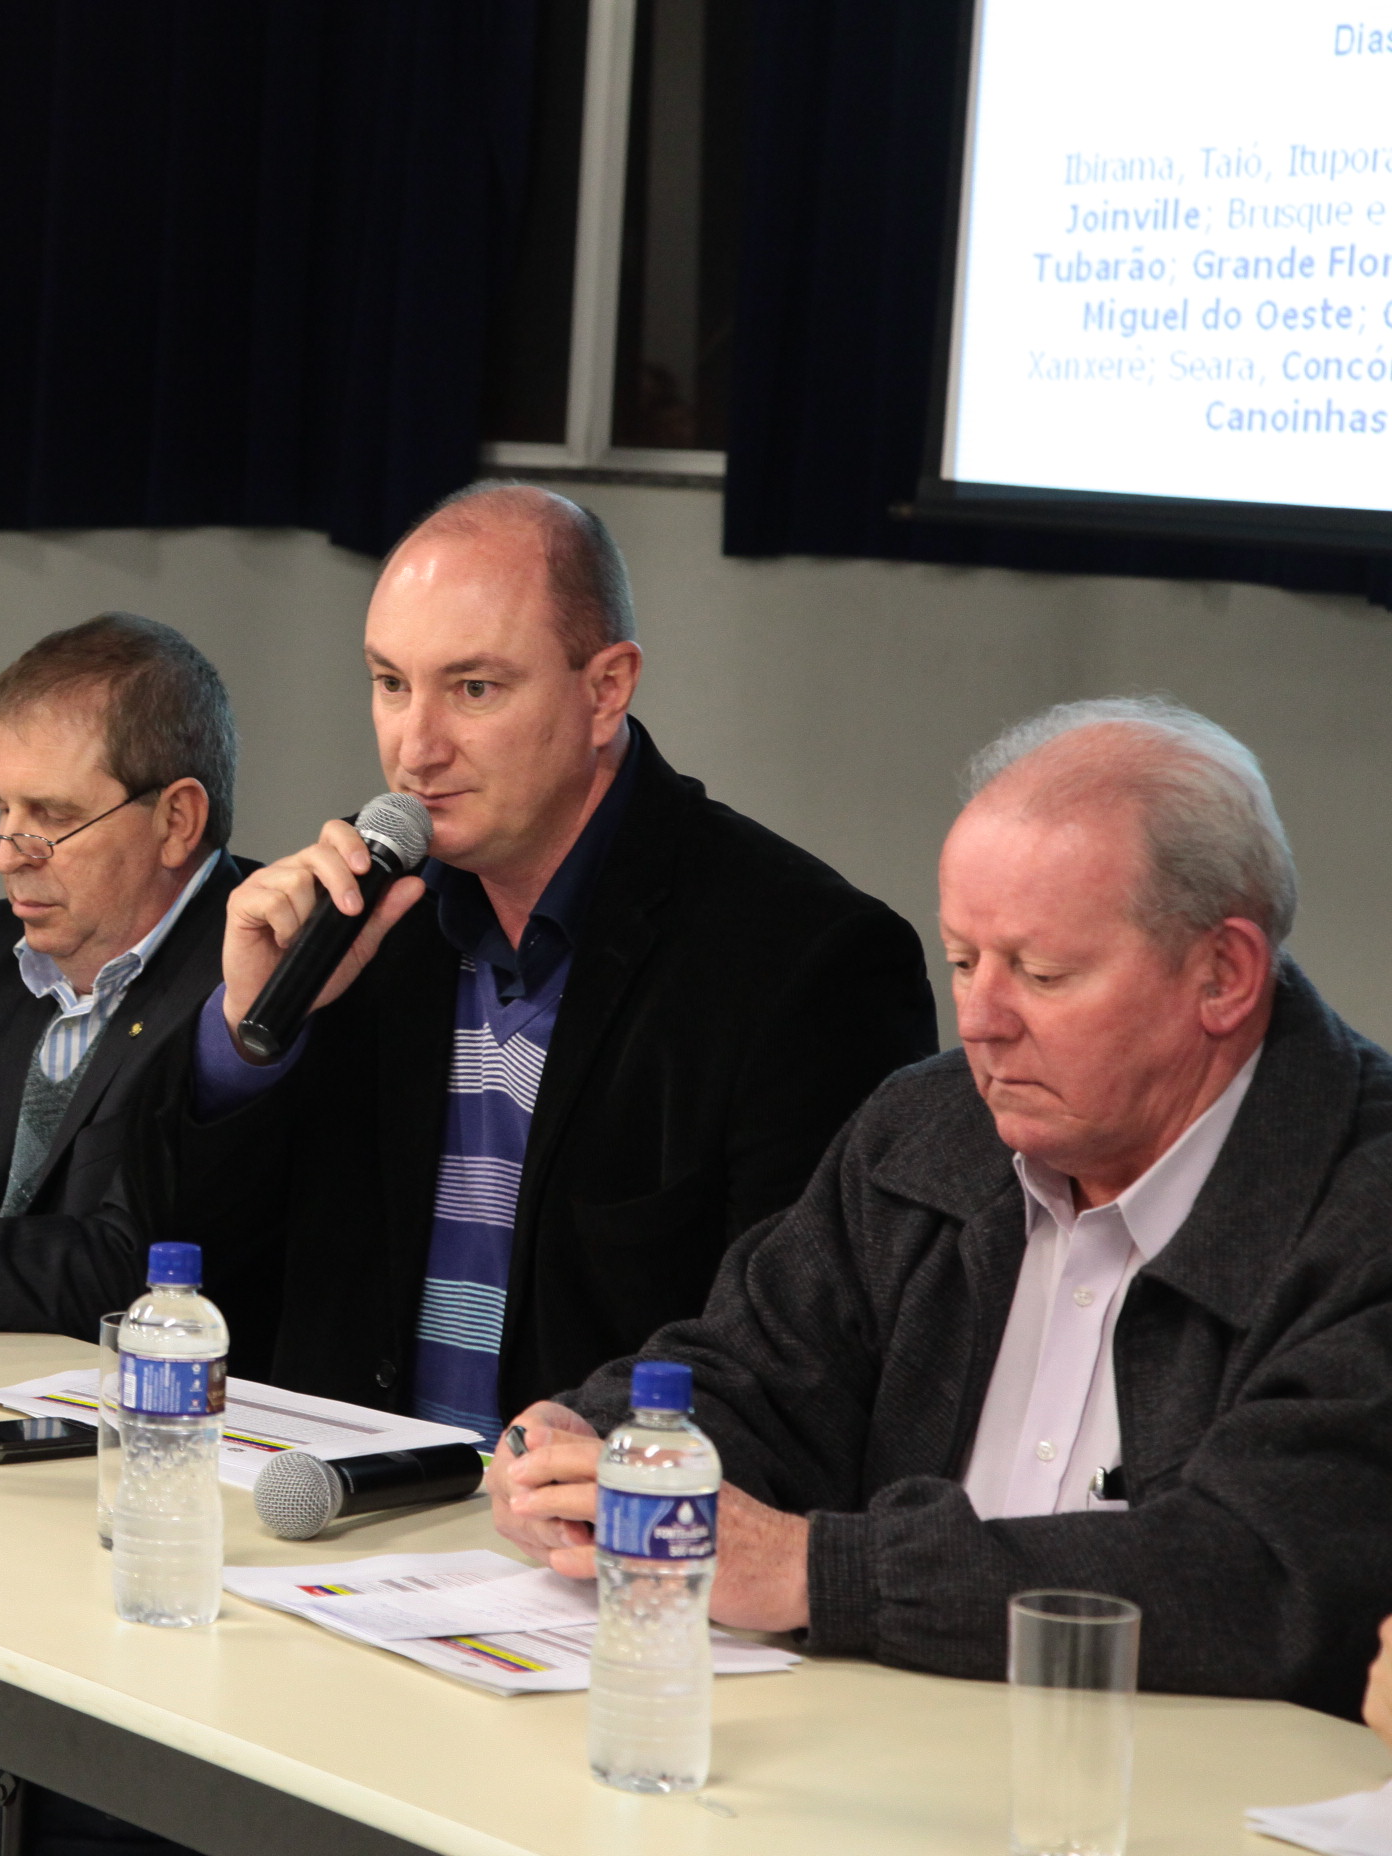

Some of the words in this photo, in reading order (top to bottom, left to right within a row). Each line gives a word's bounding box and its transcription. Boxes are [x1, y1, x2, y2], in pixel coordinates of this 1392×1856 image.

[1064, 152, 1185, 187] Ibirama,
[1200, 141, 1273, 184] Taió,
[1065, 197, 1213, 236] Joinville;
[1227, 196, 1354, 235] Brusque
[1366, 200, 1387, 226] e
[1032, 245, 1177, 285] Tubarão;
[1192, 245, 1316, 280] Grande
[1082, 297, 1189, 339] Miguel
[1201, 296, 1243, 331] do
[1256, 297, 1367, 336] Oeste;
[1169, 350, 1266, 386] Seara,
[1204, 397, 1388, 435] Canoinhas
